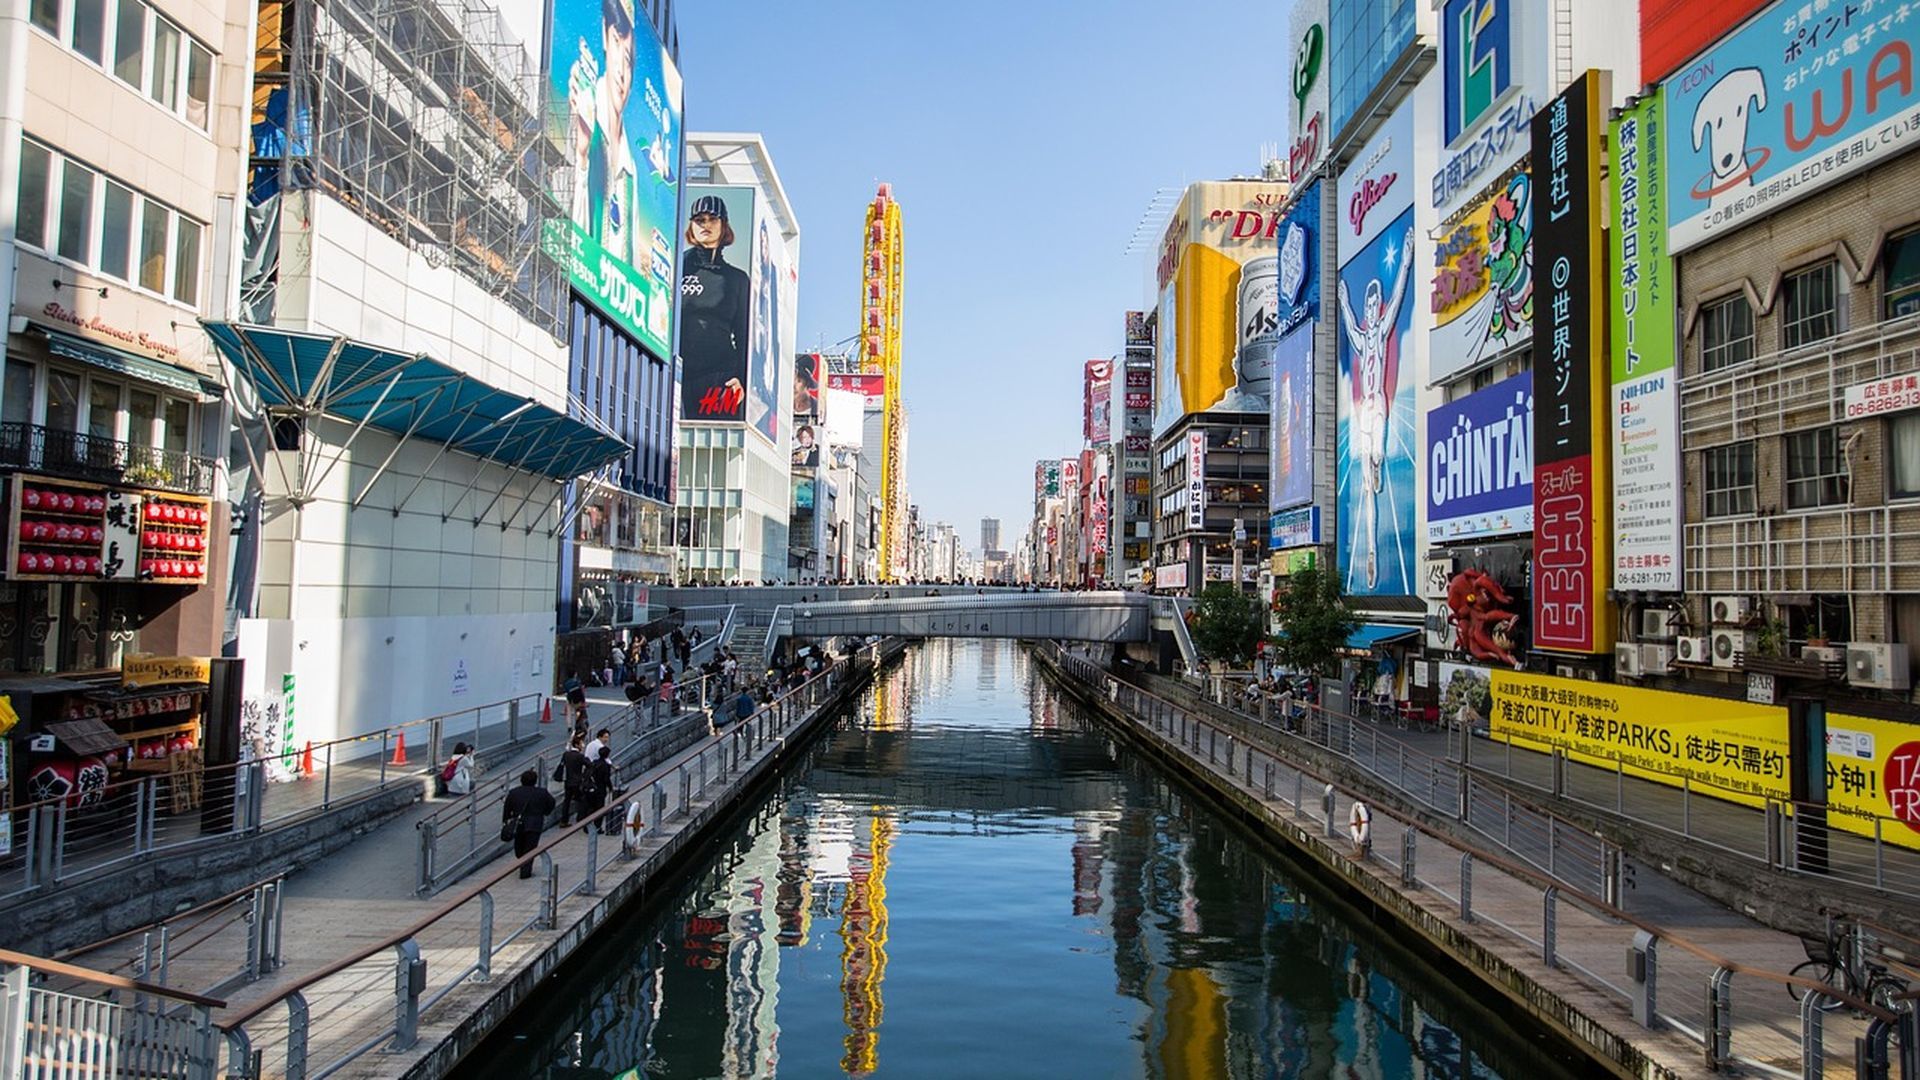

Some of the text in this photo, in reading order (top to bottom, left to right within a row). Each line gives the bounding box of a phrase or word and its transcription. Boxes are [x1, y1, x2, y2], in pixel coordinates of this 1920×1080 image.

[1432, 94, 1535, 208] 日商エステム
[1350, 172, 1398, 237] Glico
[1619, 117, 1640, 375] 株式会社日本リート
[1620, 377, 1664, 400] NIHON
[1864, 375, 1917, 400] 広告募集
[1618, 554, 1671, 569] 広告主募集中
[1618, 572, 1671, 585] 06-6281-1717
[1749, 674, 1773, 691] BAR
[1713, 772, 1729, 786] from
[1751, 780, 1763, 792] We
